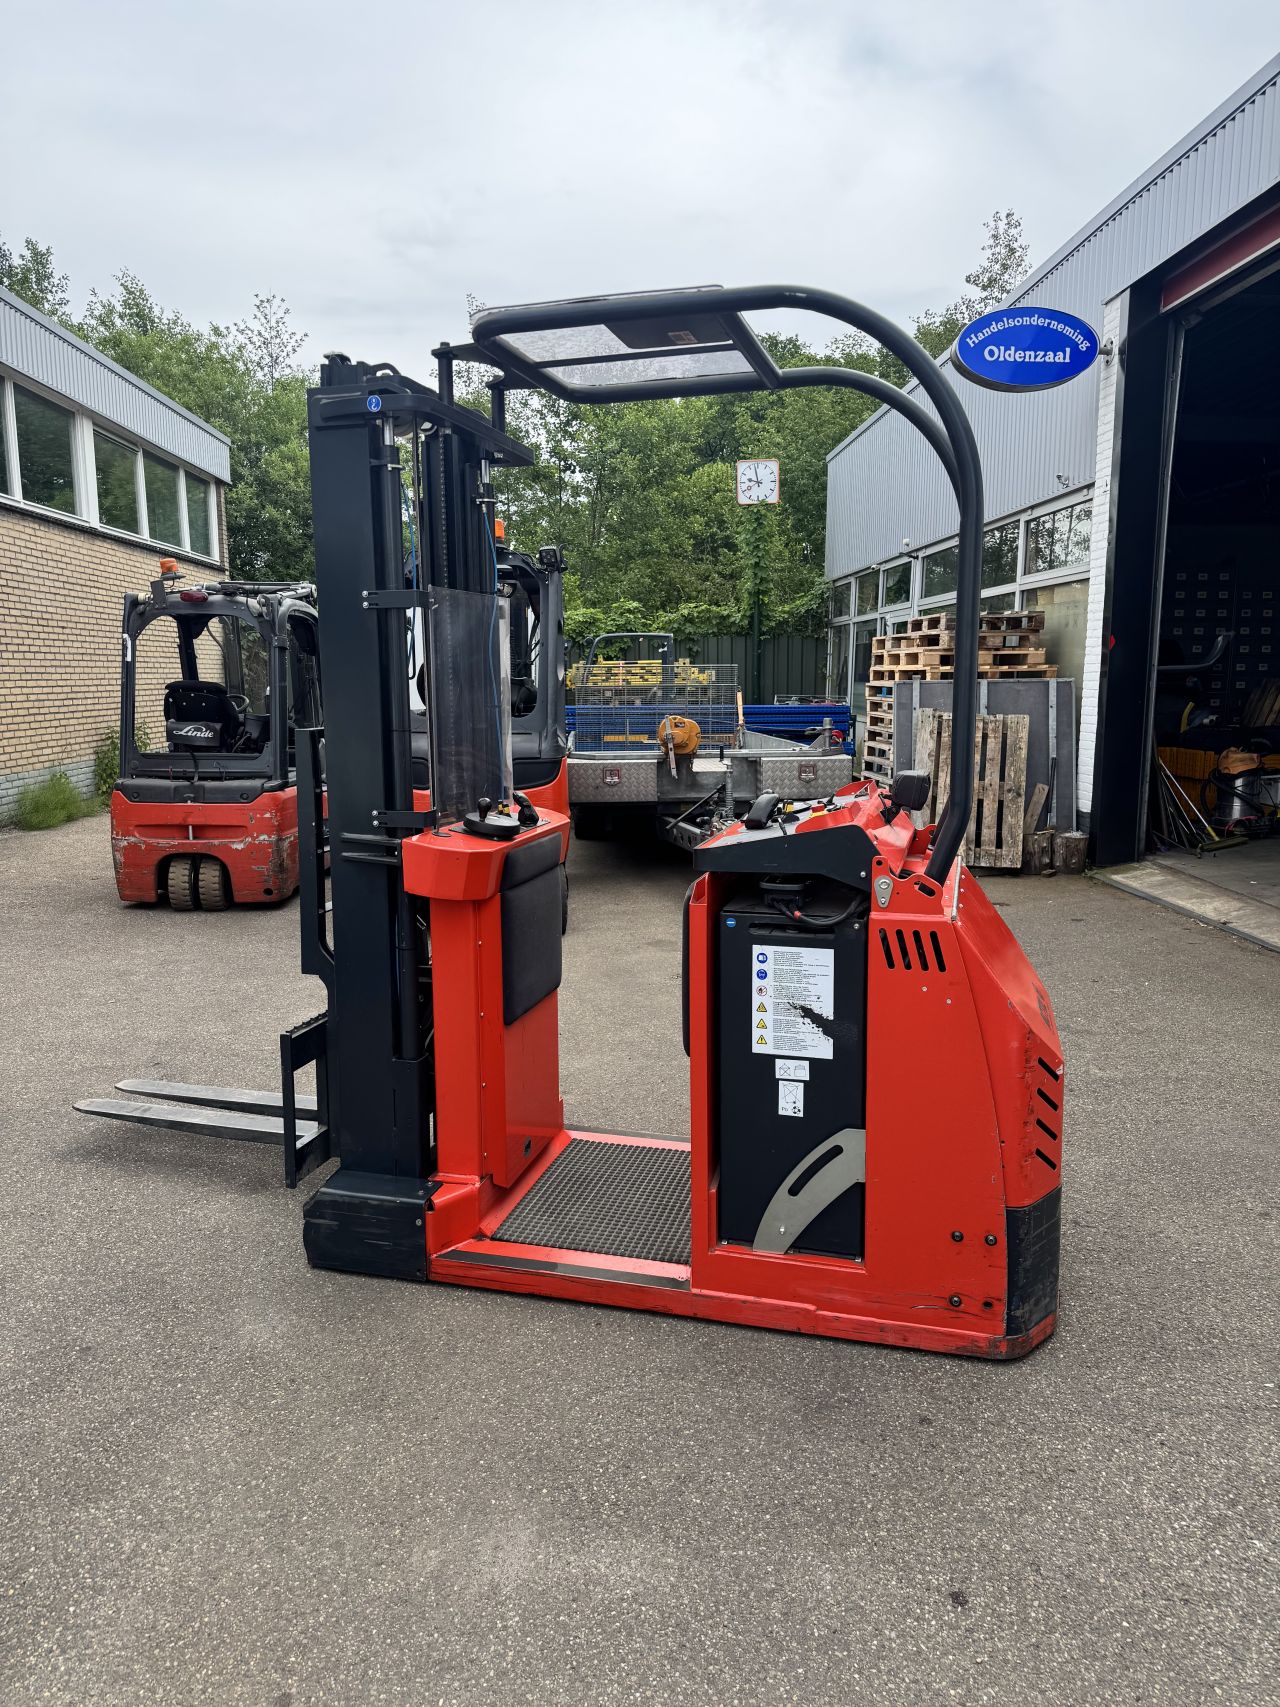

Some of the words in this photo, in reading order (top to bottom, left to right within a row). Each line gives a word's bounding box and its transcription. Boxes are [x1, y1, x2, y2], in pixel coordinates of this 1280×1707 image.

[966, 314, 1090, 351] Handelsonderneming
[984, 345, 1070, 363] Oldenzaal
[173, 725, 214, 738] Linde
